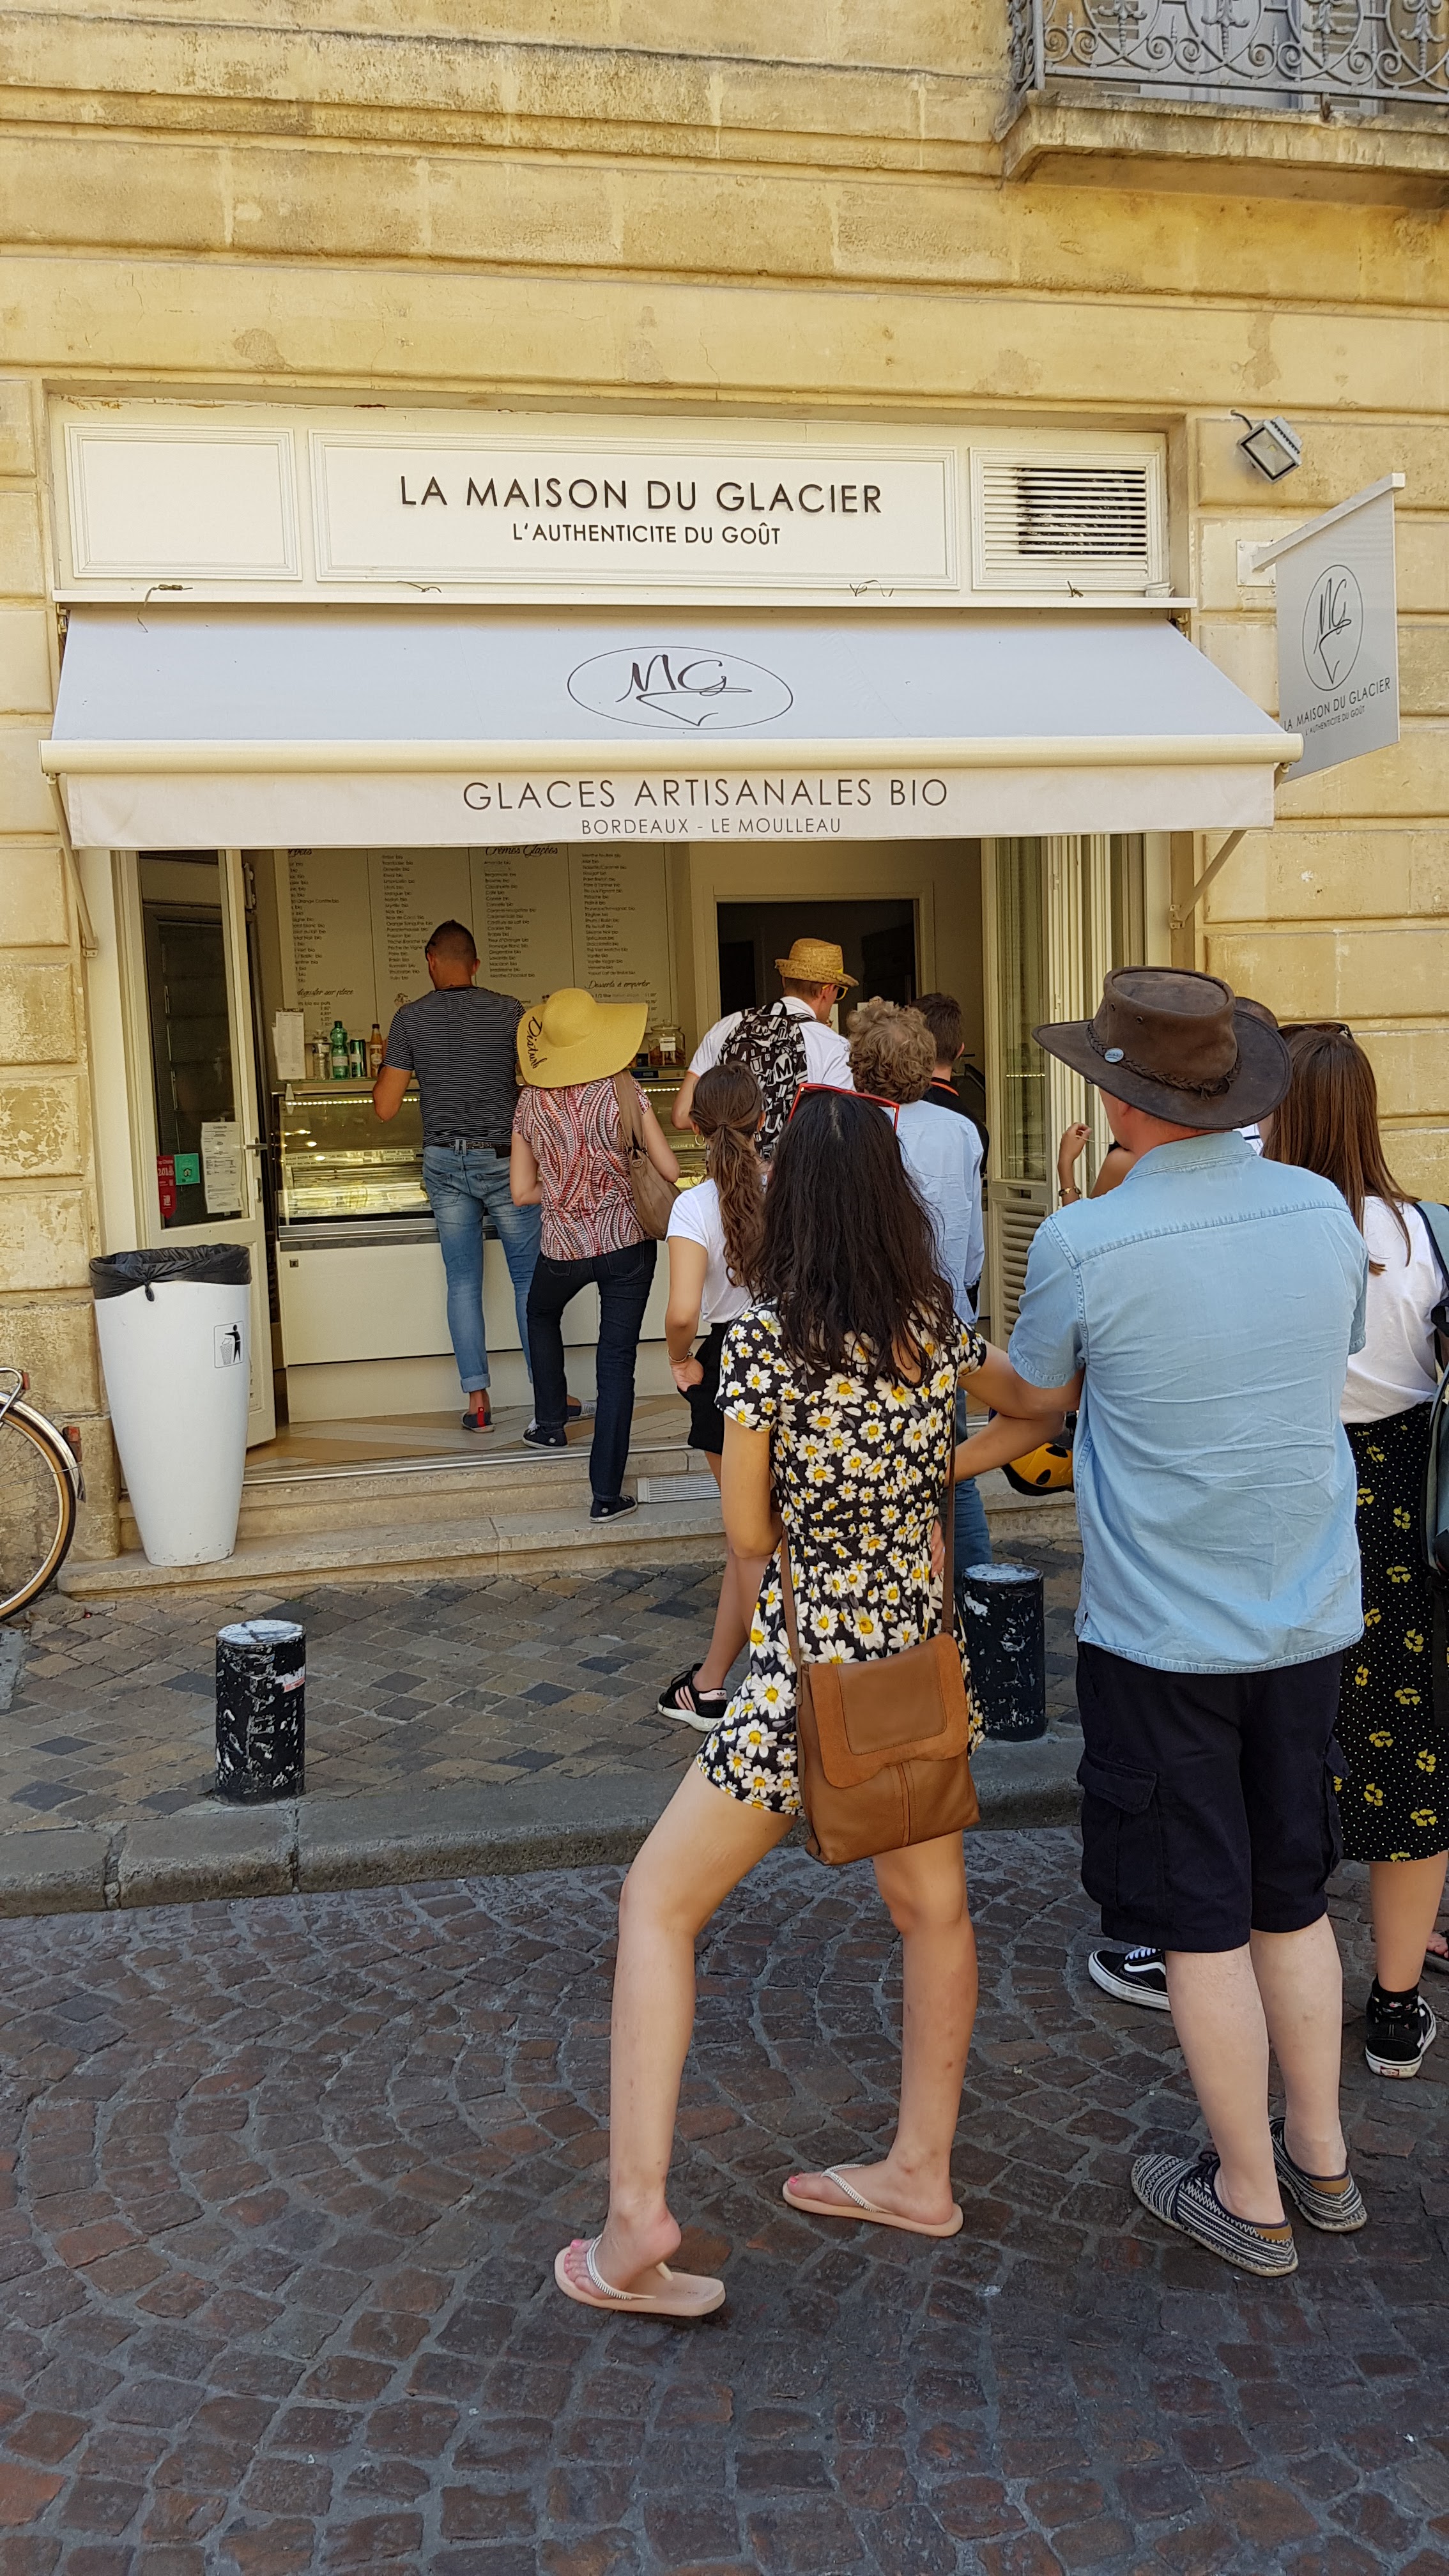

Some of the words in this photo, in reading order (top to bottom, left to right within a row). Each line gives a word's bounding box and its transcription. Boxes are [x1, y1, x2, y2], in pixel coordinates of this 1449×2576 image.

[401, 476, 447, 505] LA
[467, 477, 626, 509] MAISON
[648, 480, 695, 510] DU
[716, 482, 881, 513] GLACIER
[513, 523, 676, 542] L'AUTHENTICITE
[685, 526, 712, 544] DU
[722, 523, 780, 545] GOÛT
[1284, 719, 1292, 732] LA
[1296, 702, 1330, 727] MAISON
[1333, 694, 1346, 711] DU
[1349, 677, 1390, 705] GLACIER
[464, 780, 614, 810] GLACES
[634, 779, 871, 806] ARTISANALES
[891, 779, 947, 806] BIO
[582, 819, 688, 834] BORDEAUX
[712, 818, 730, 833] LE
[739, 818, 840, 833] MOULLEAU
